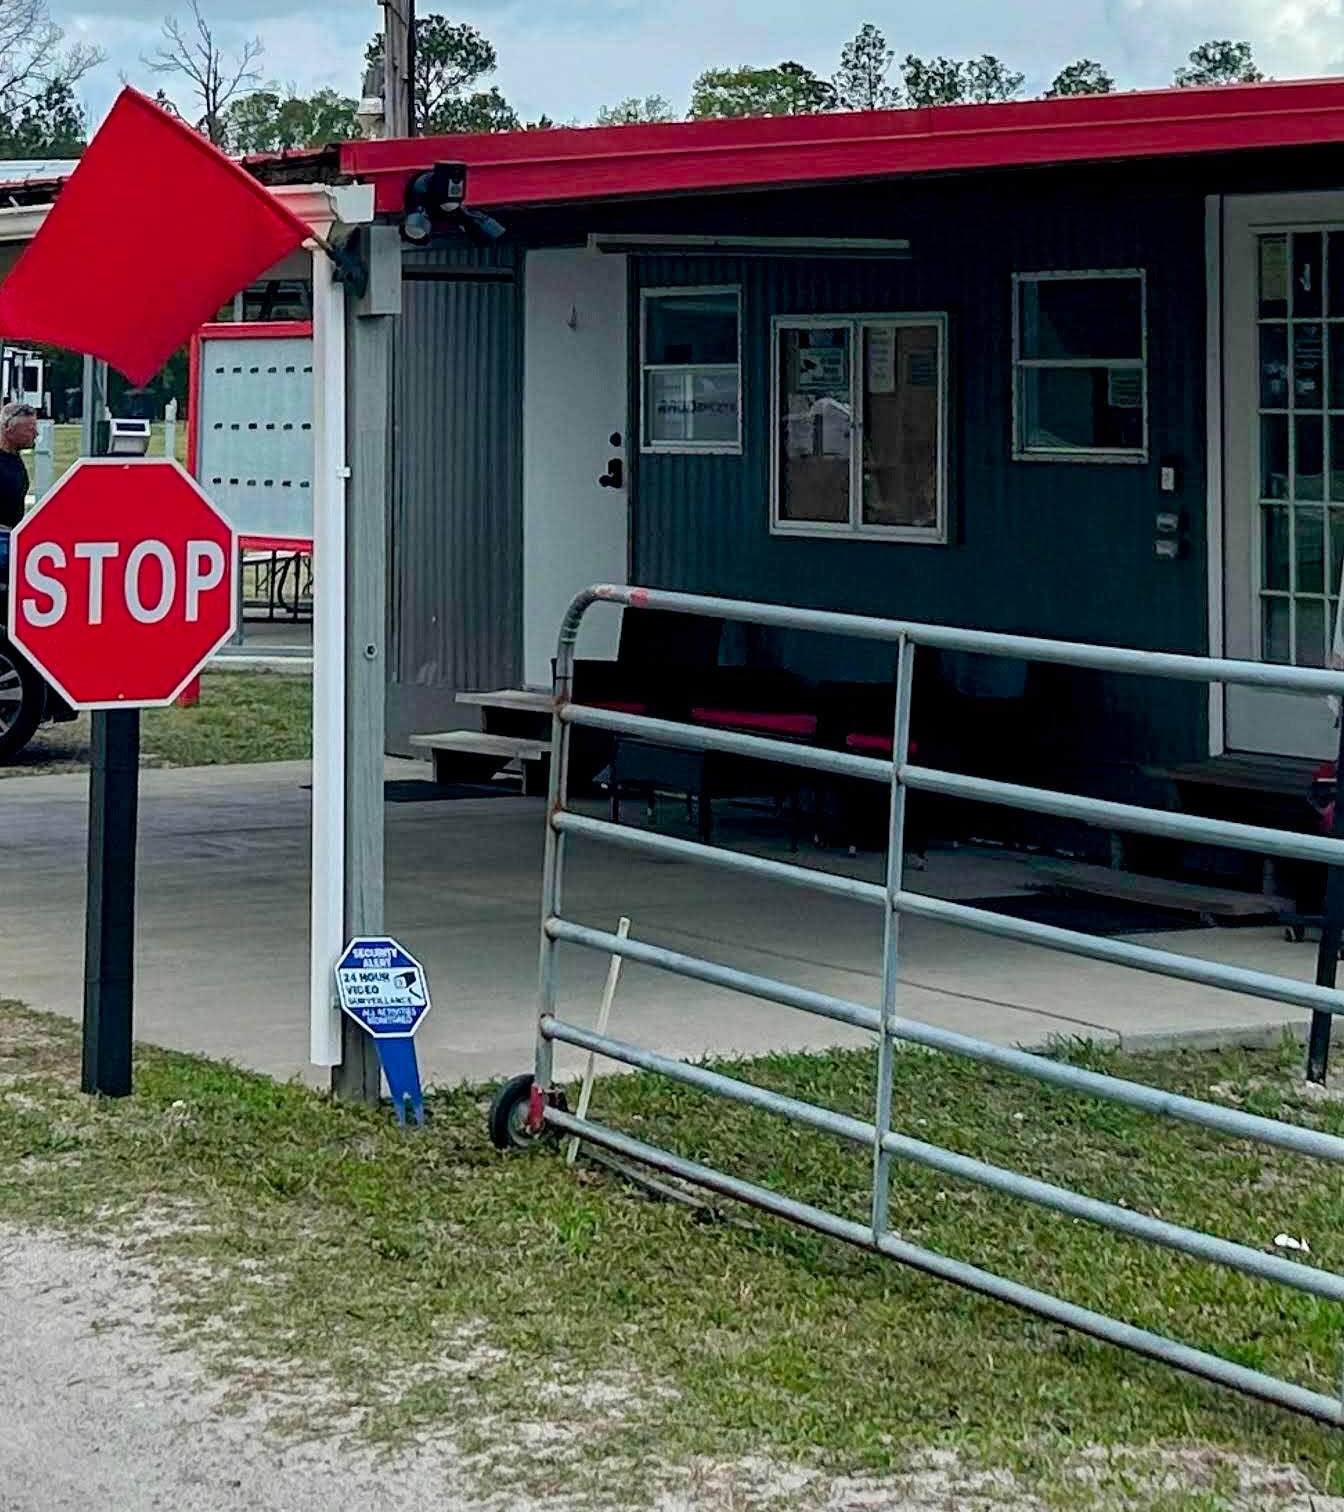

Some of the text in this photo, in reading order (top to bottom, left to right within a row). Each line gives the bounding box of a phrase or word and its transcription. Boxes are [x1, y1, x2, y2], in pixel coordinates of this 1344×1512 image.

[22, 539, 225, 627] STOP
[343, 972, 391, 984] 24 HOUR
[346, 985, 380, 995] VIDEO
